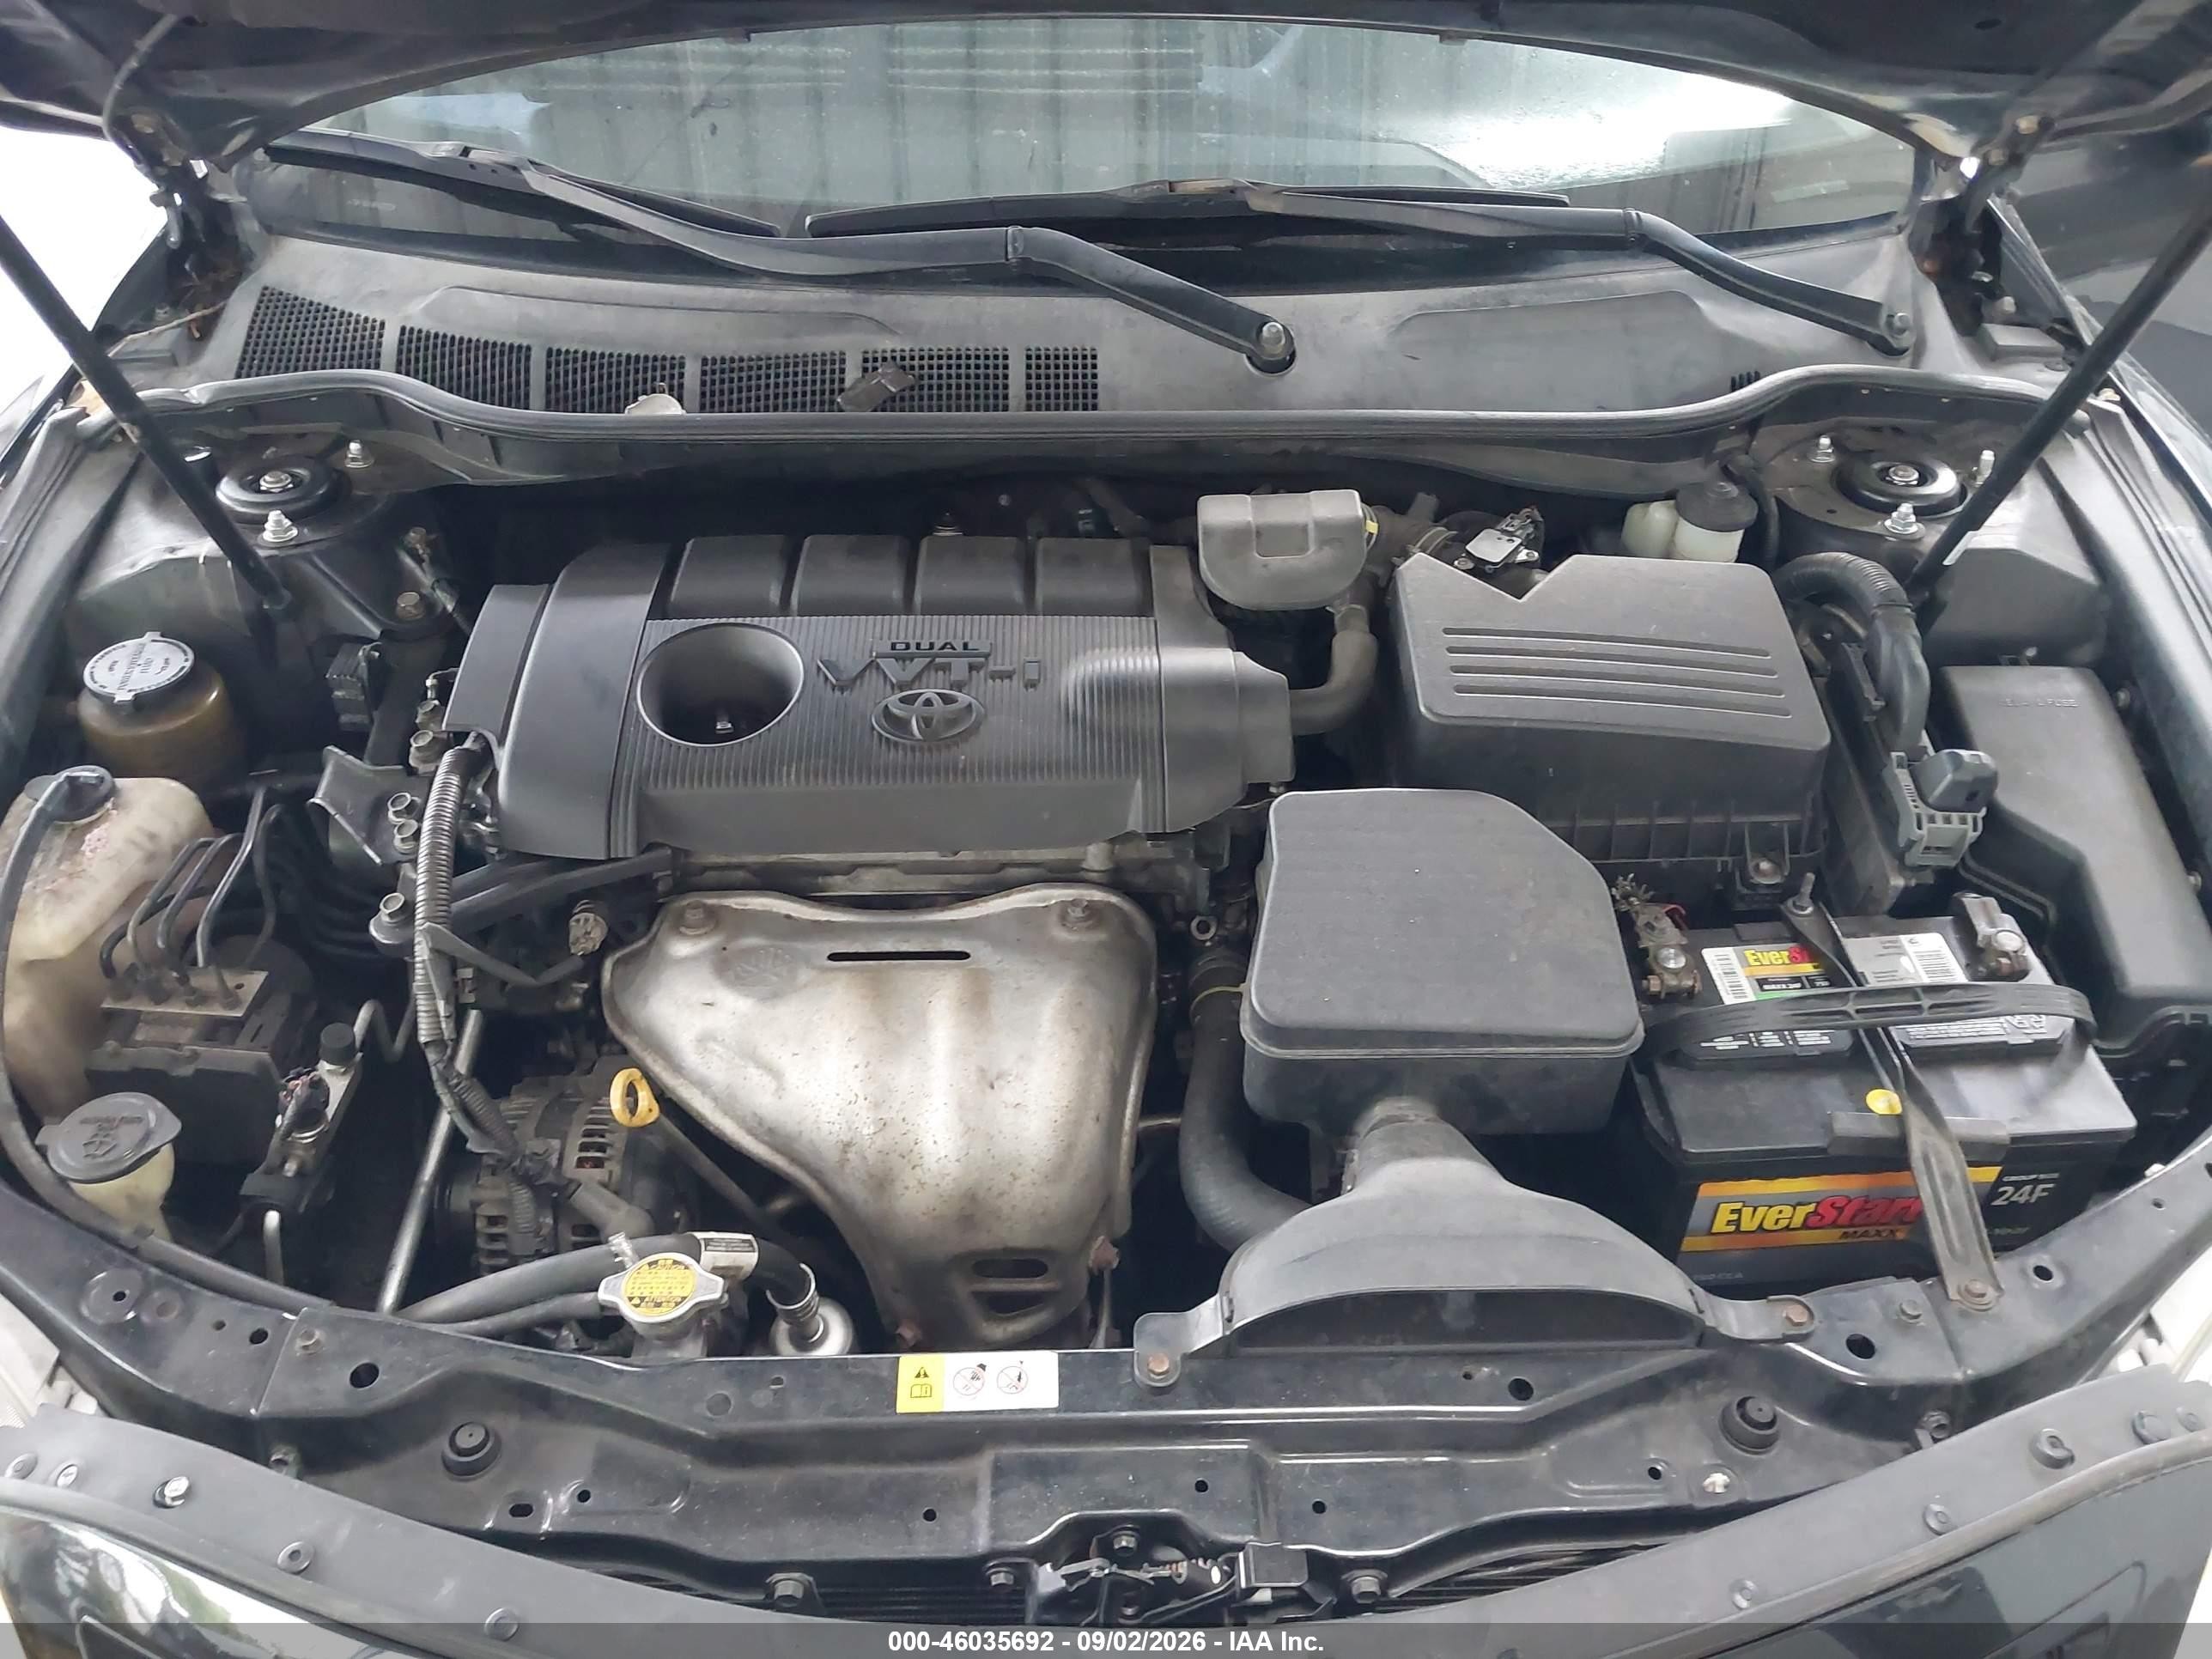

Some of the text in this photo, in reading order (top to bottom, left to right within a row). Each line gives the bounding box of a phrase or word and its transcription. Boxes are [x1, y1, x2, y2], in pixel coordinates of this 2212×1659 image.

[890, 641, 981, 652] DUAL
[817, 657, 1042, 688] VVT-i
[1990, 1183, 2057, 1206] 24F
